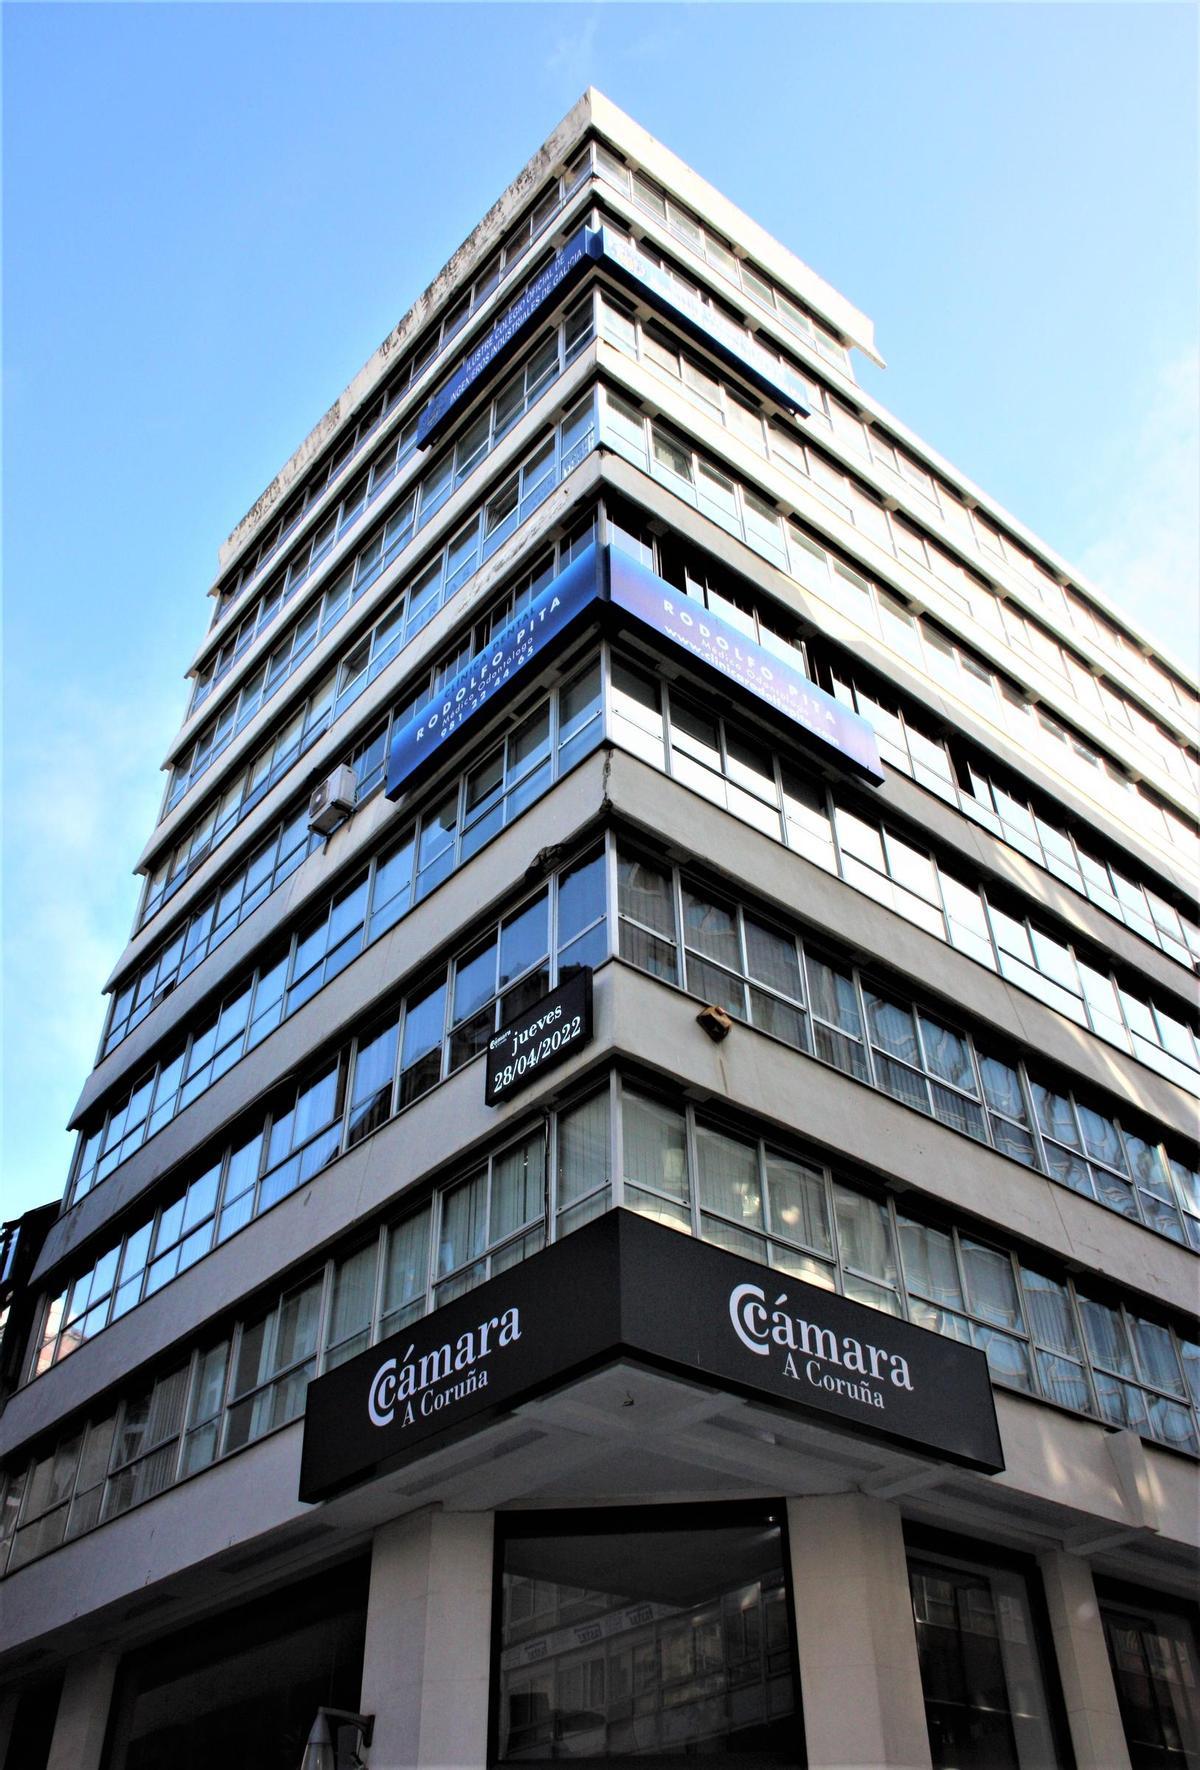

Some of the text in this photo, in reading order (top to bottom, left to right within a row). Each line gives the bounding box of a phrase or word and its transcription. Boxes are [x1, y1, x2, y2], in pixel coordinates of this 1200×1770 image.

[494, 299, 526, 339] COLEGIO
[526, 269, 554, 303] OFICIAL
[554, 253, 566, 271] DE
[541, 281, 552, 300] DE
[552, 249, 582, 287] GALICIA
[492, 606, 535, 652] DENTAL
[663, 599, 836, 725] RODOLFO PITA
[416, 597, 561, 742] RODOLFO PITA
[441, 645, 533, 738] 981 22 44 65
[493, 1016, 581, 1093] 28/04/2022
[511, 1005, 562, 1056] jueves
[401, 1368, 488, 1428] A Coruña
[782, 1352, 885, 1409] A Coruña
